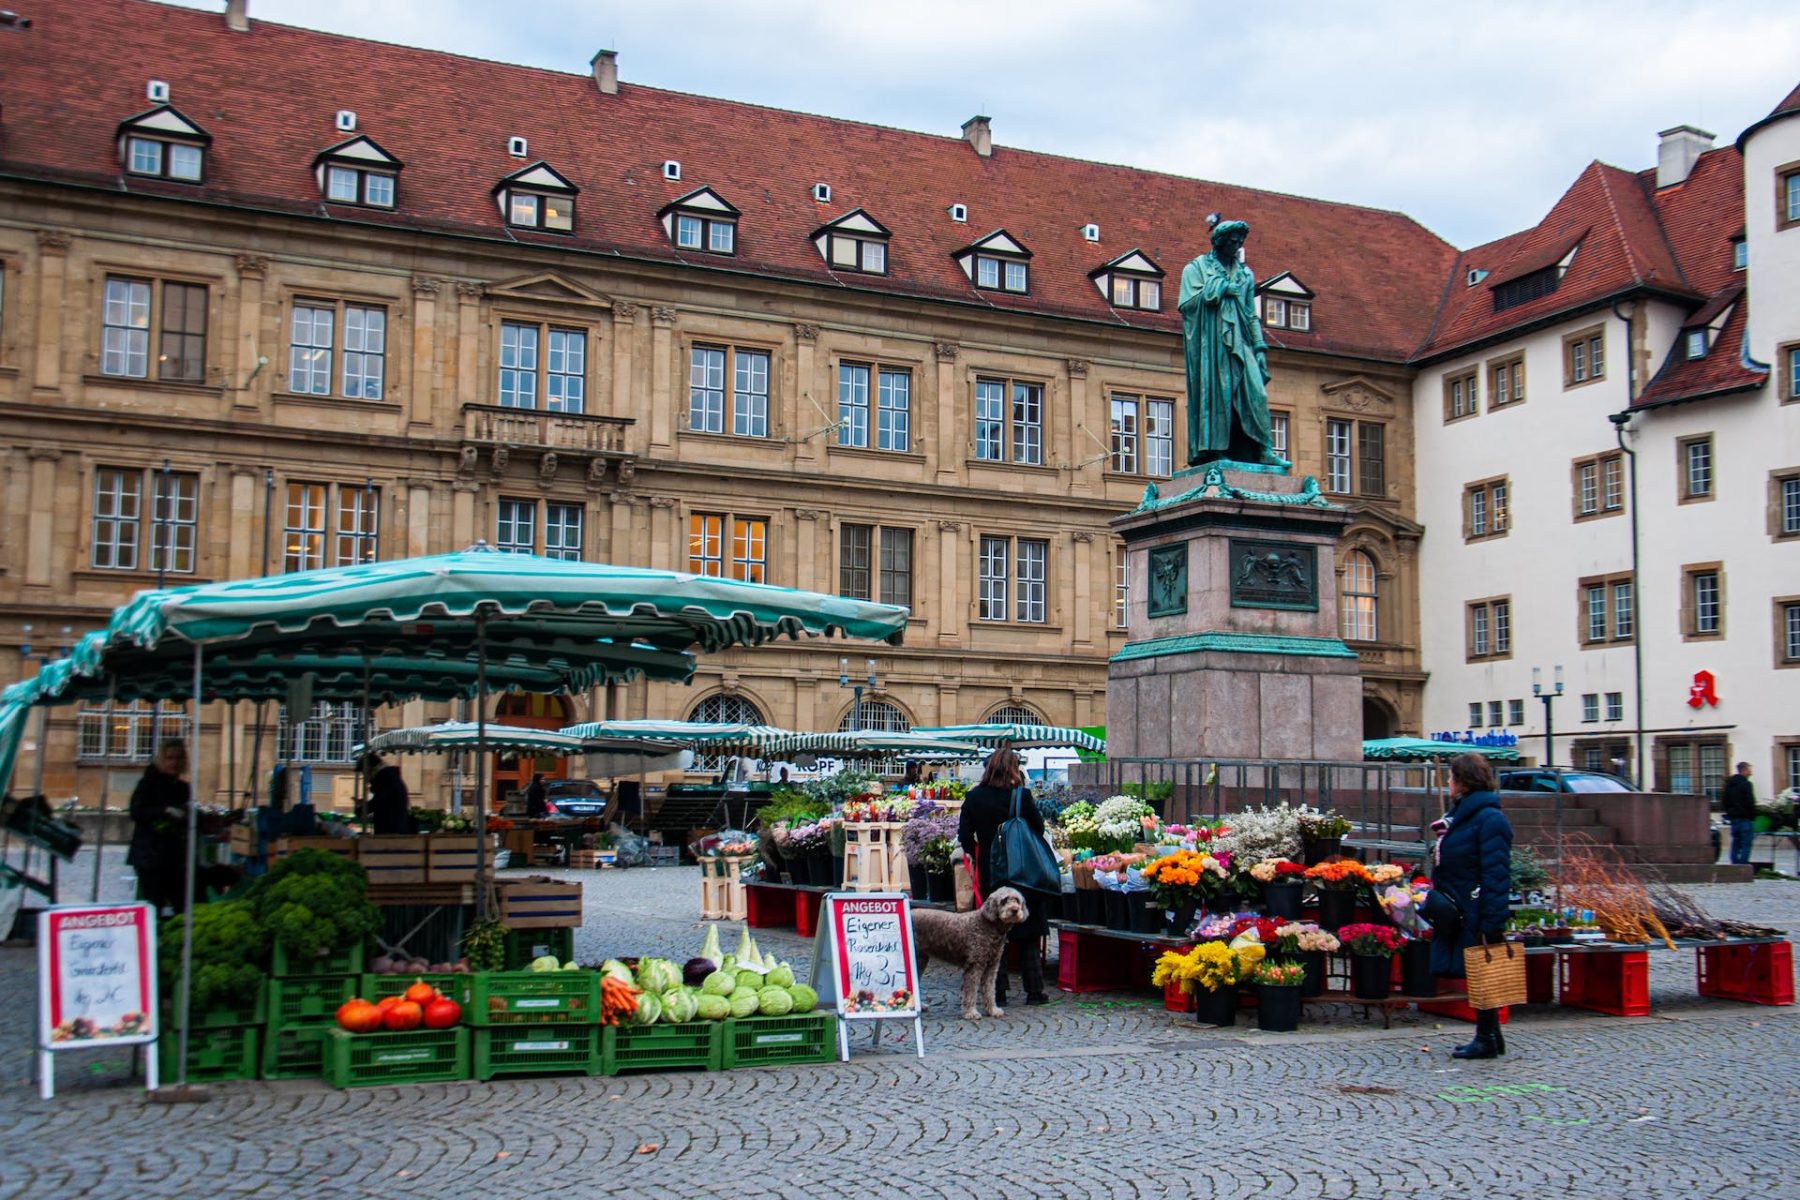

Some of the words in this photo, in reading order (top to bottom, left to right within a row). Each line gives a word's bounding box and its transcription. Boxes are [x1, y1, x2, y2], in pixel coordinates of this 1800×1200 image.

[842, 901, 898, 913] ANGEBOT
[59, 911, 137, 929] ANGEBOT
[847, 917, 895, 939] Eigener
[852, 960, 872, 986] 1kg
